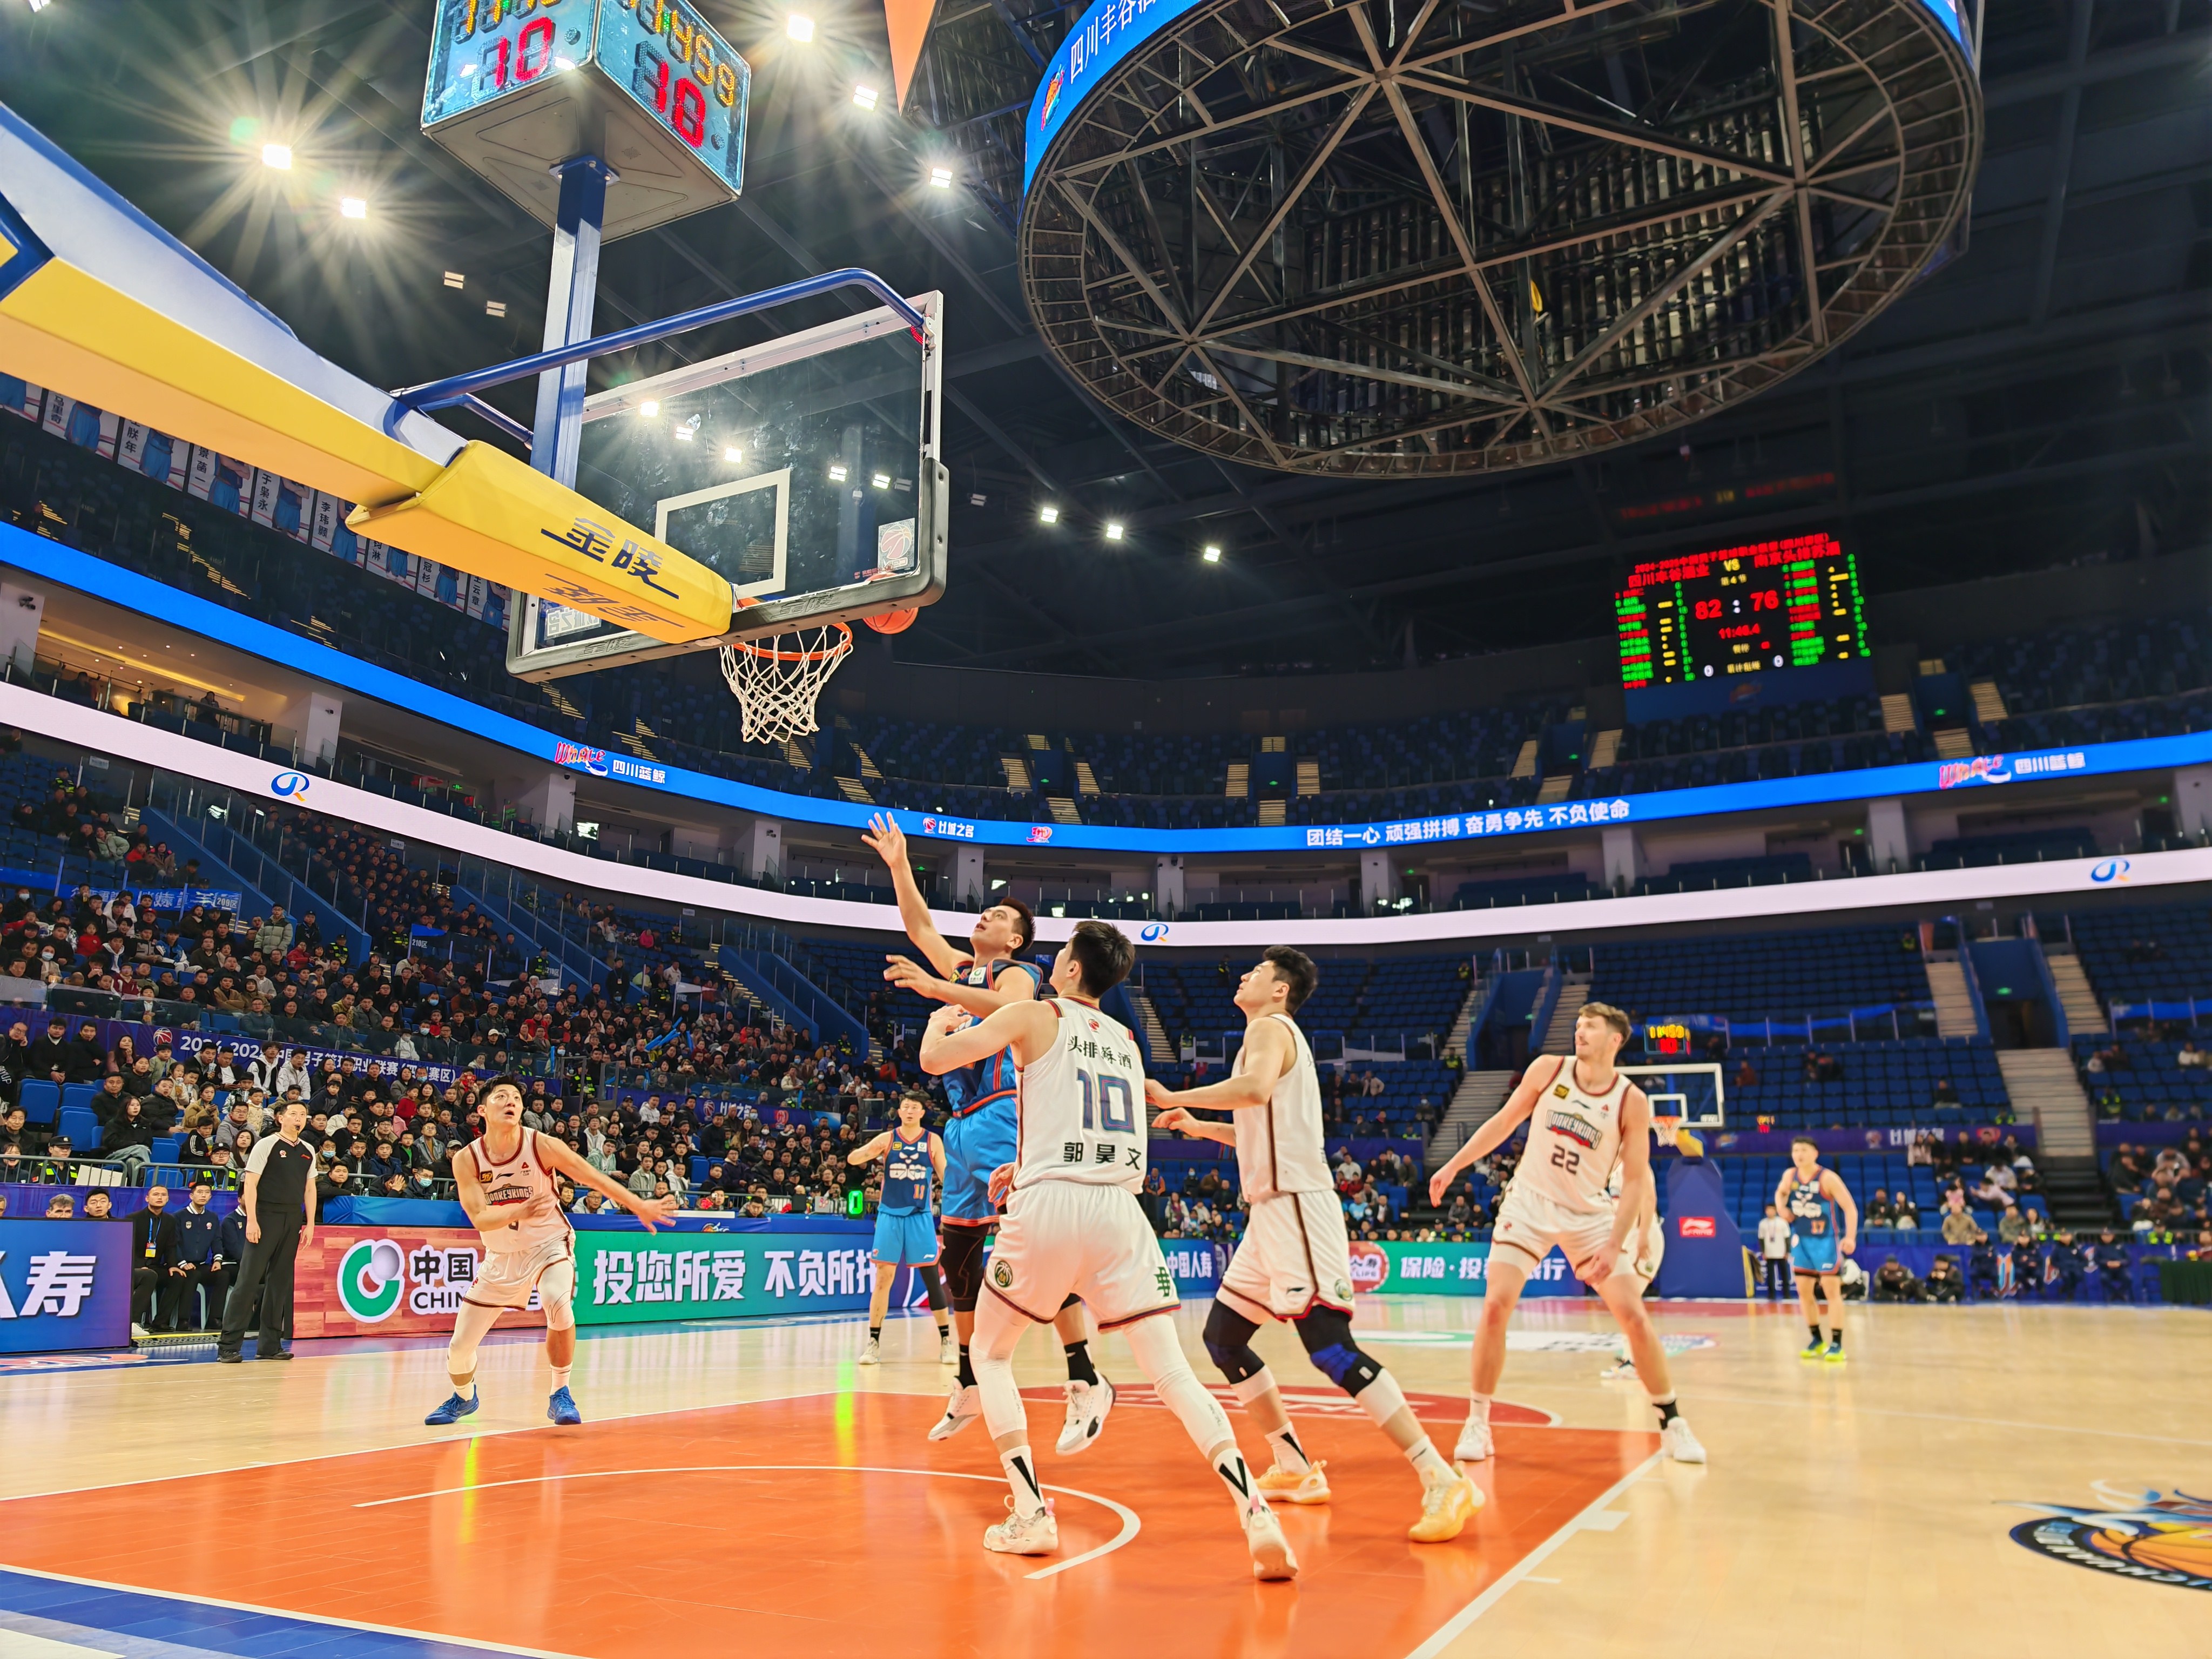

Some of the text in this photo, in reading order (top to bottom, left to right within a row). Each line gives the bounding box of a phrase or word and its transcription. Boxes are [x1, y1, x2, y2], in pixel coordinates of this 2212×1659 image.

[495, 17, 553, 89] 10
[1071, 0, 1156, 84] 四川丰谷
[422, 559, 433, 583] 冠杉
[1723, 558, 1740, 571] VS
[1695, 598, 1722, 619] 82
[1750, 590, 1779, 611] 76
[613, 759, 665, 784] 四川蓝鲸
[938, 820, 974, 838] 以城之名
[1307, 799, 1630, 847] 团结一心 顽强拼搏 奋勇争先 不负使命
[412, 939, 428, 948] 210区
[1076, 1067, 1136, 1135] 10
[1063, 1142, 1142, 1170] 郭昊文
[1550, 1144, 1580, 1175] 22
[849, 1191, 863, 1214] 0
[413, 1250, 474, 1285] 中国
[592, 1250, 746, 1305] 投您所爱
[1166, 1251, 1212, 1278] 中国人寿
[0, 1251, 97, 1318] 寿
